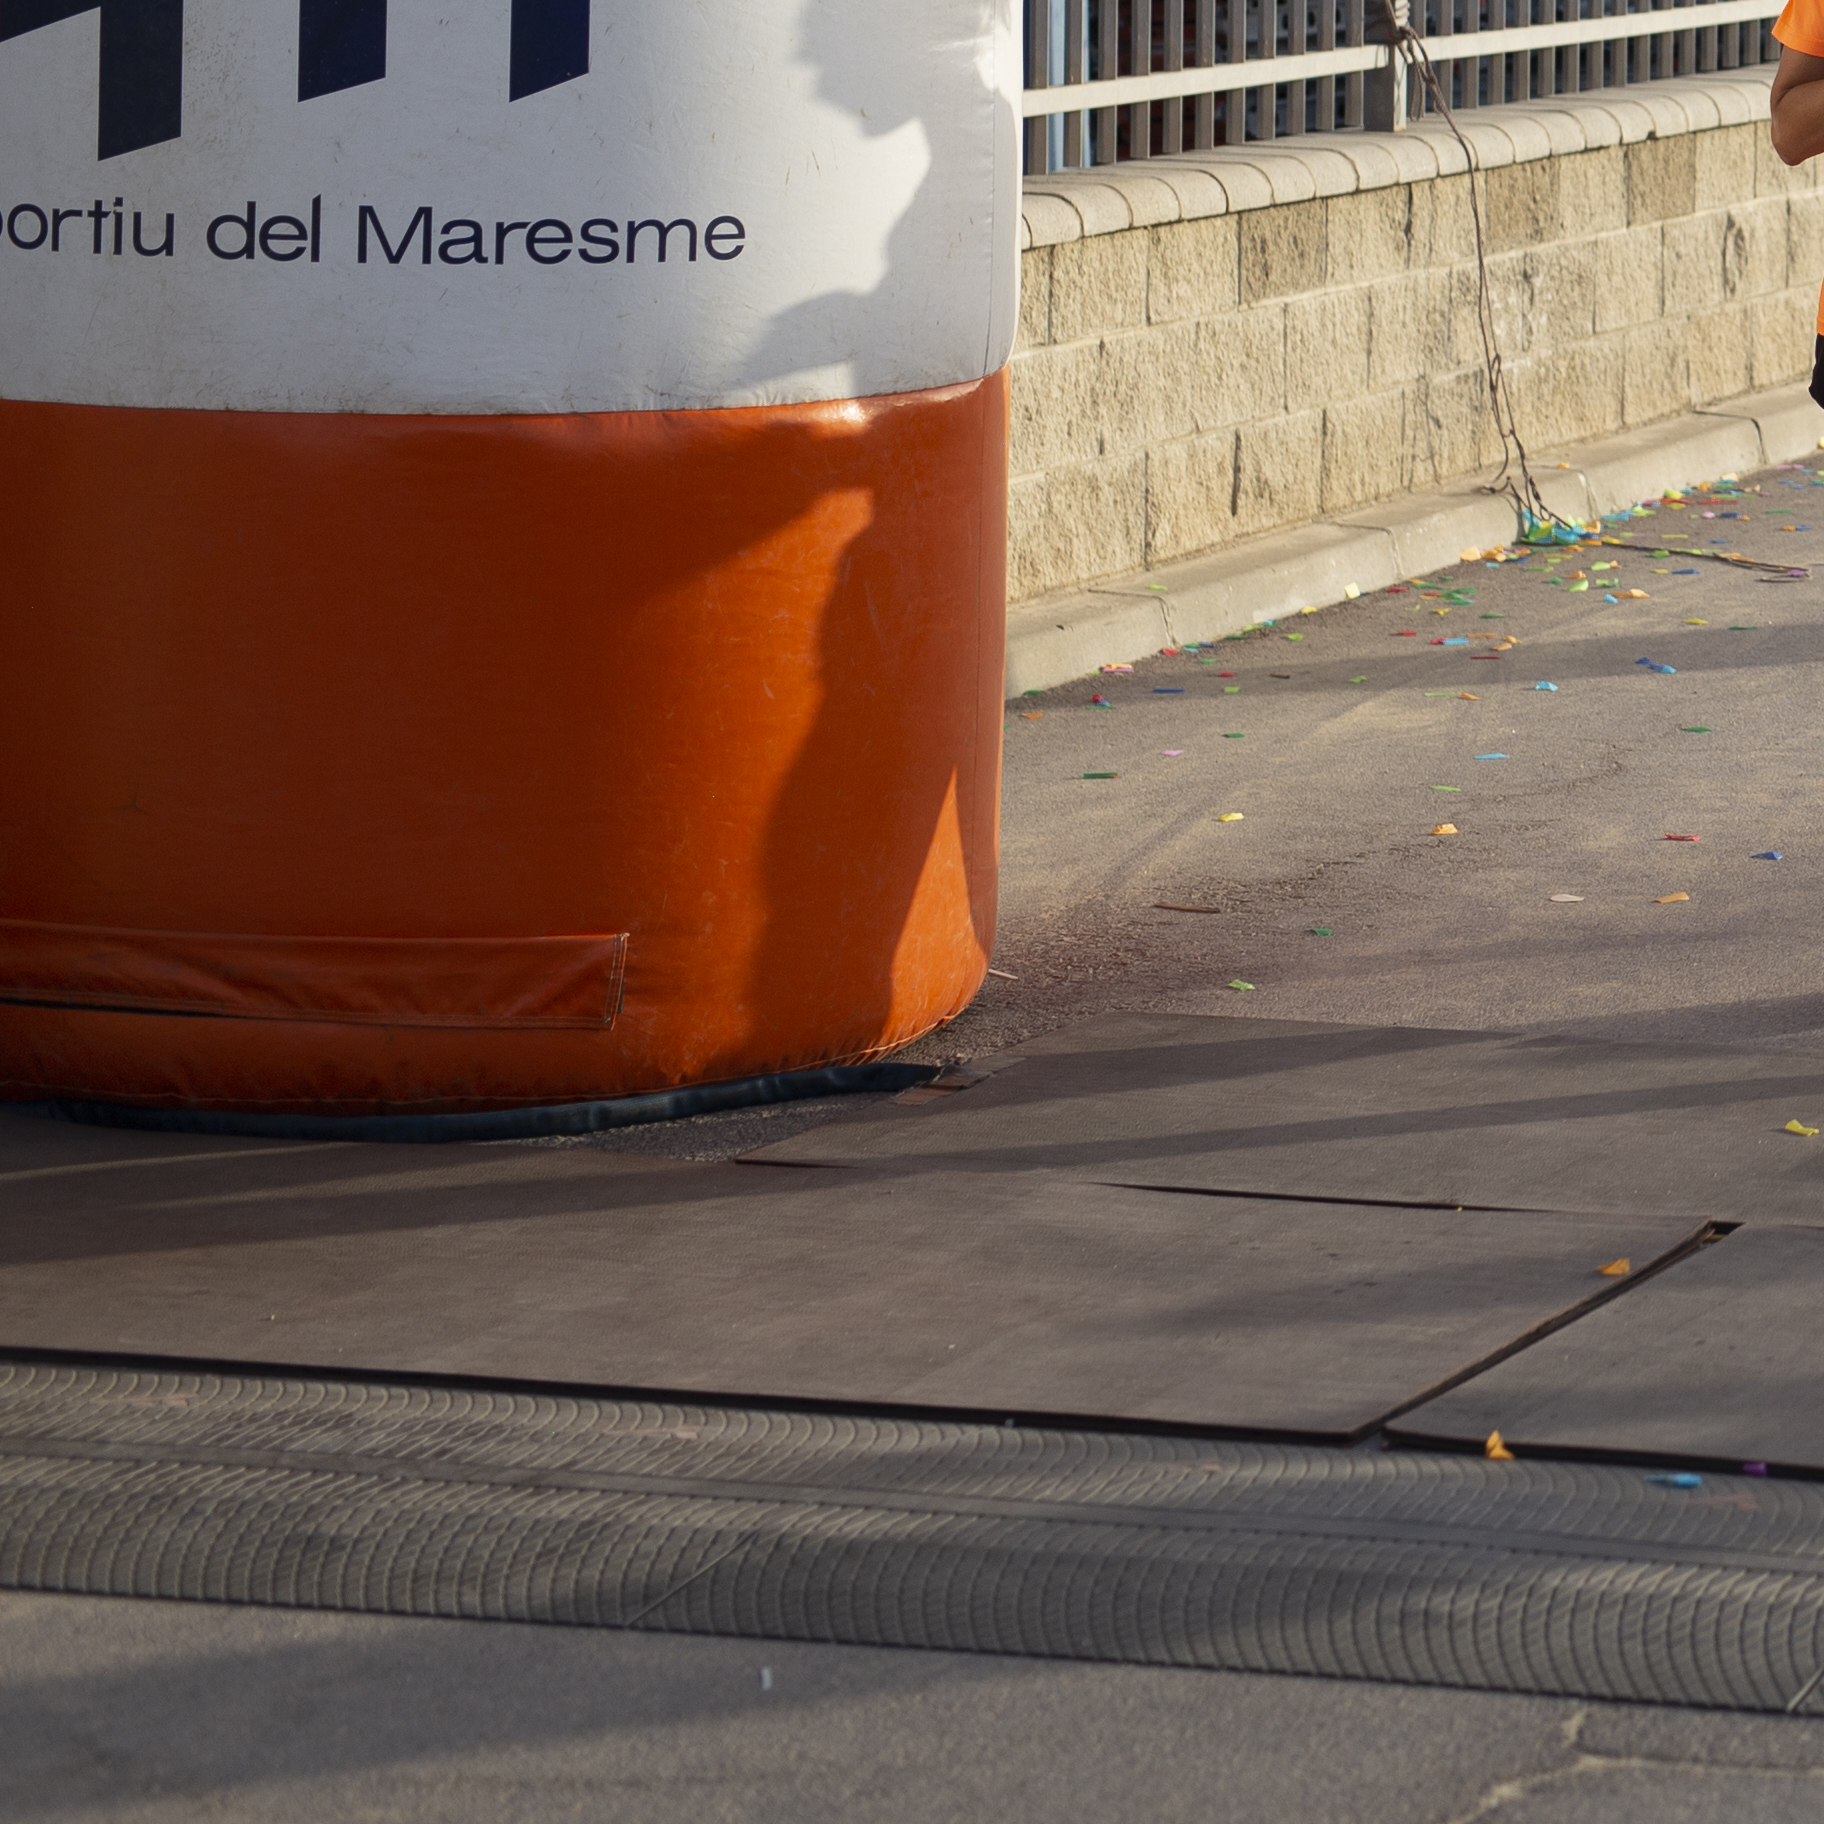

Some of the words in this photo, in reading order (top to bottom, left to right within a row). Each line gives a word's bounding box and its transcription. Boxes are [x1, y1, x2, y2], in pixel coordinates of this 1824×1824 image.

[0, 196, 176, 258] ortiu
[206, 193, 322, 264] del
[357, 203, 748, 266] Maresme
